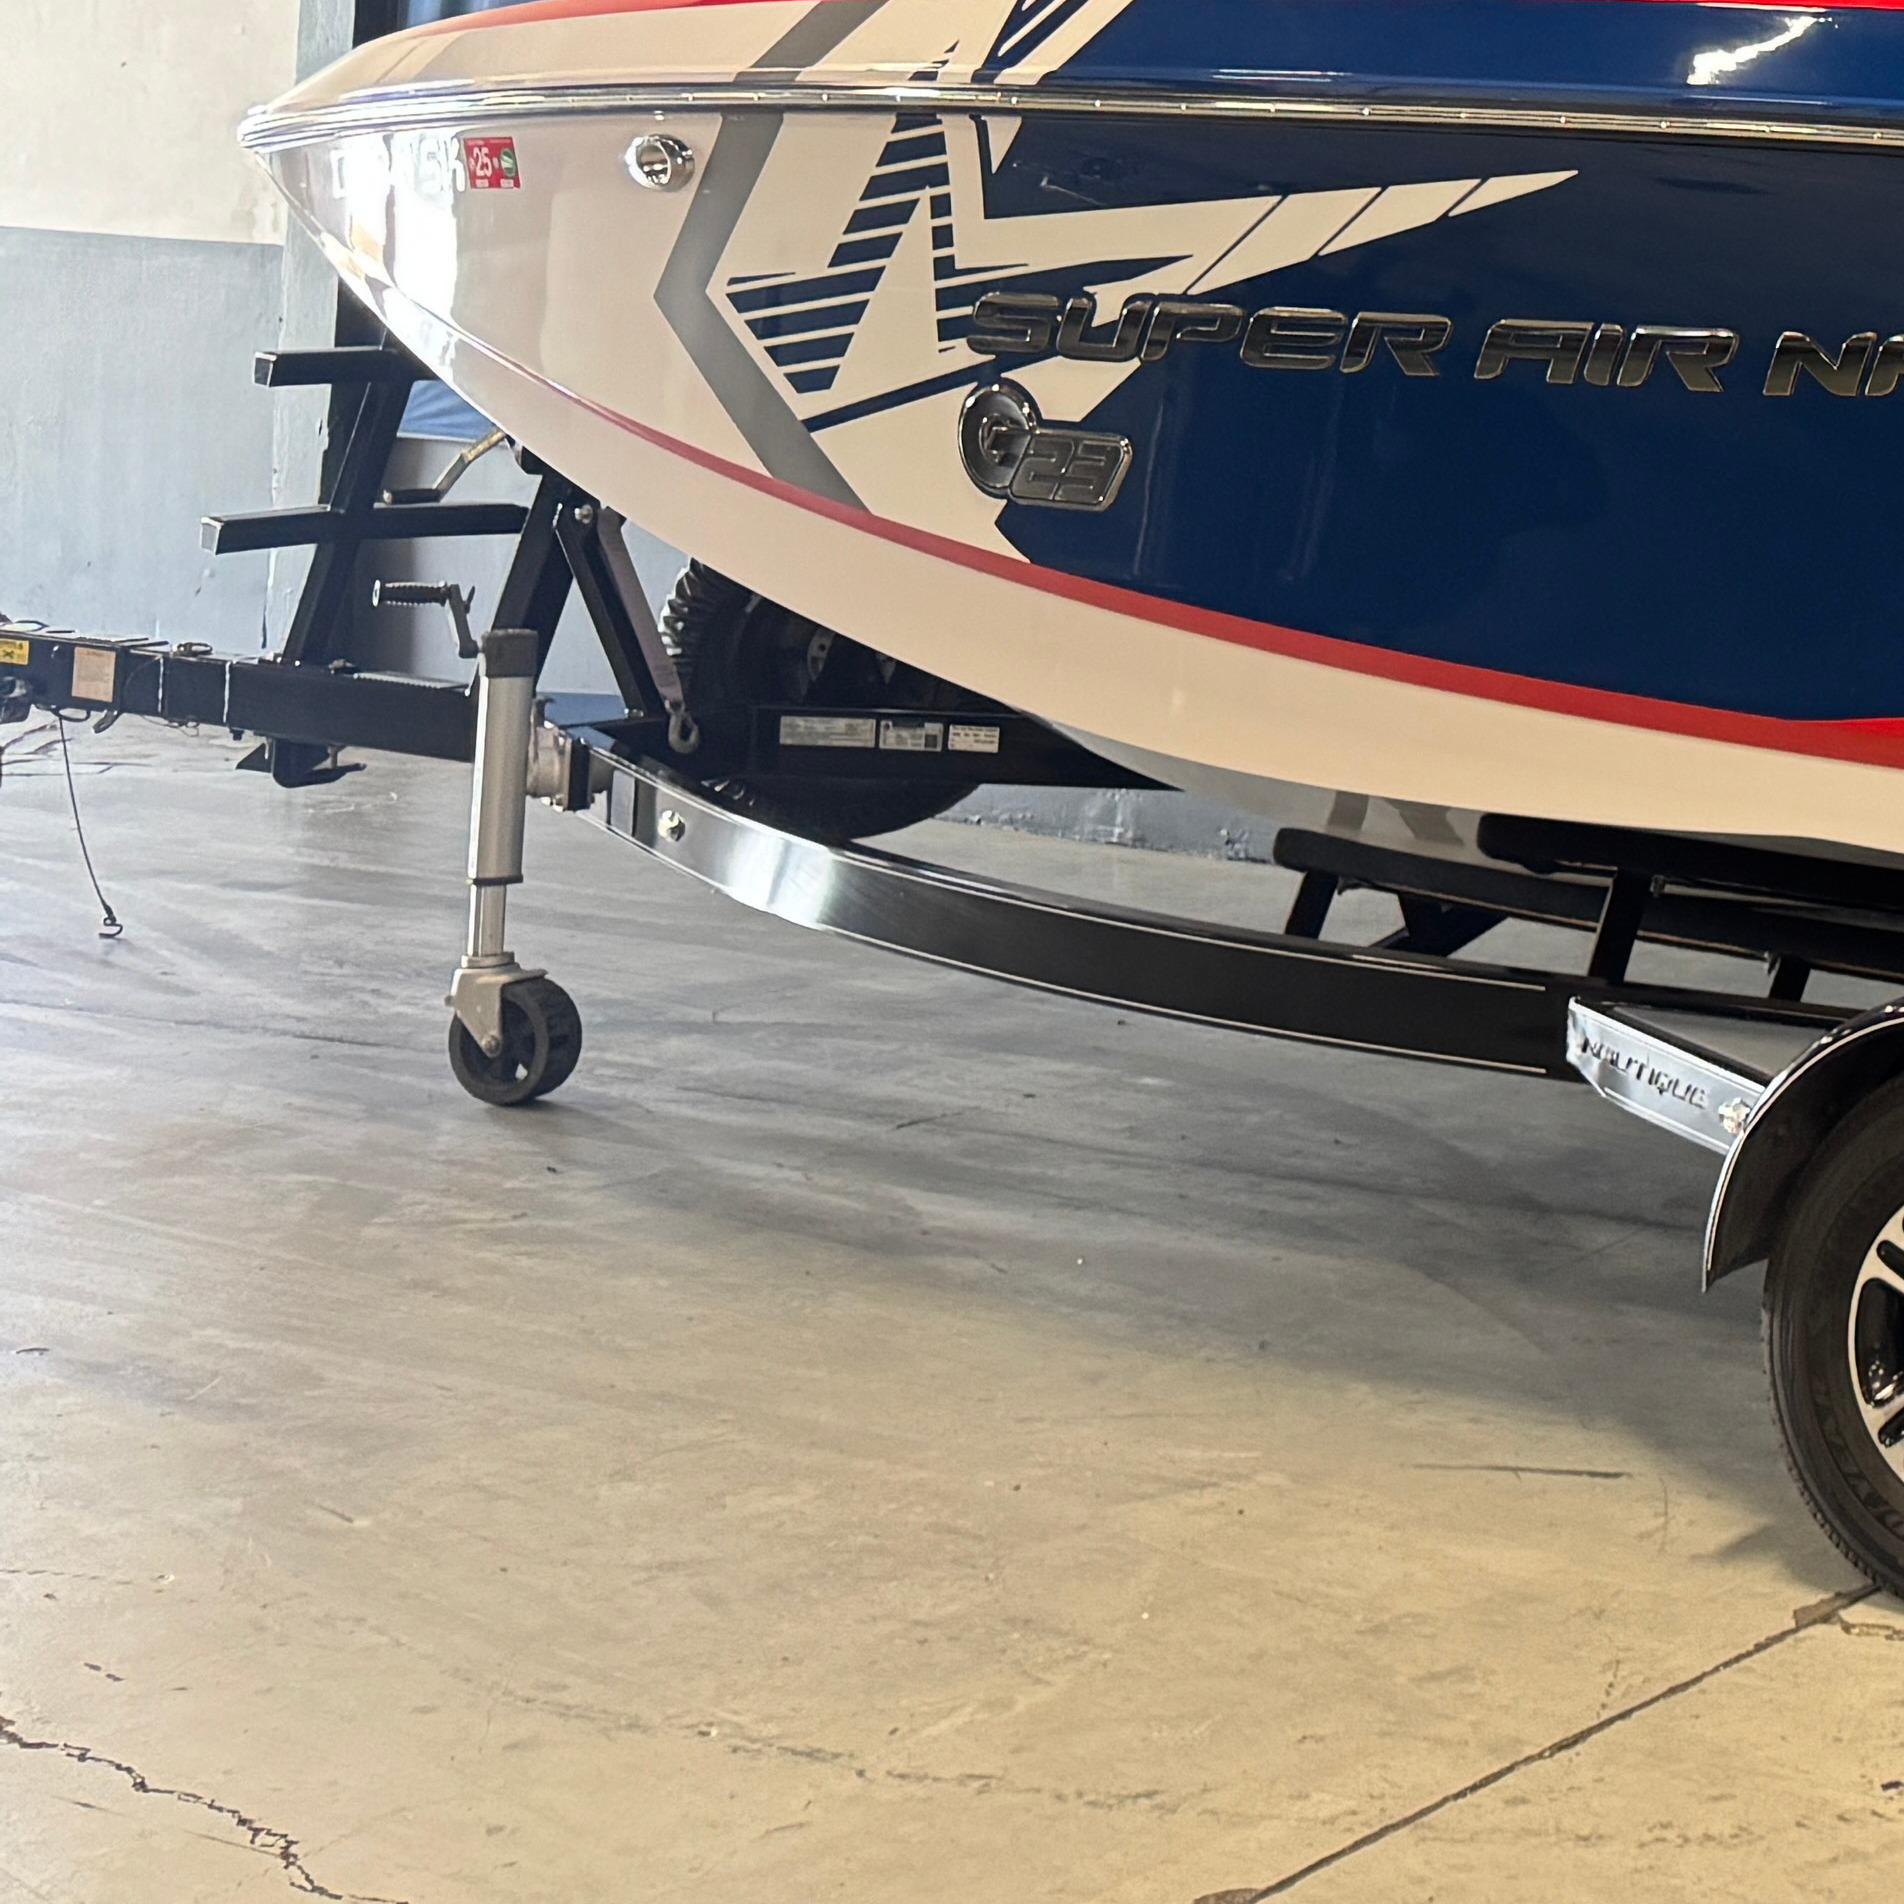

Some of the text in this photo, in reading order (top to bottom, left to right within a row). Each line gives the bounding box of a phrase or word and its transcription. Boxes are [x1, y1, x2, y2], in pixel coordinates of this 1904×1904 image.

[473, 146, 493, 177] 25
[967, 291, 1455, 378] SUPER
[1474, 318, 1740, 393] AIR
[1581, 1034, 1707, 1110] NAUTIQUE
